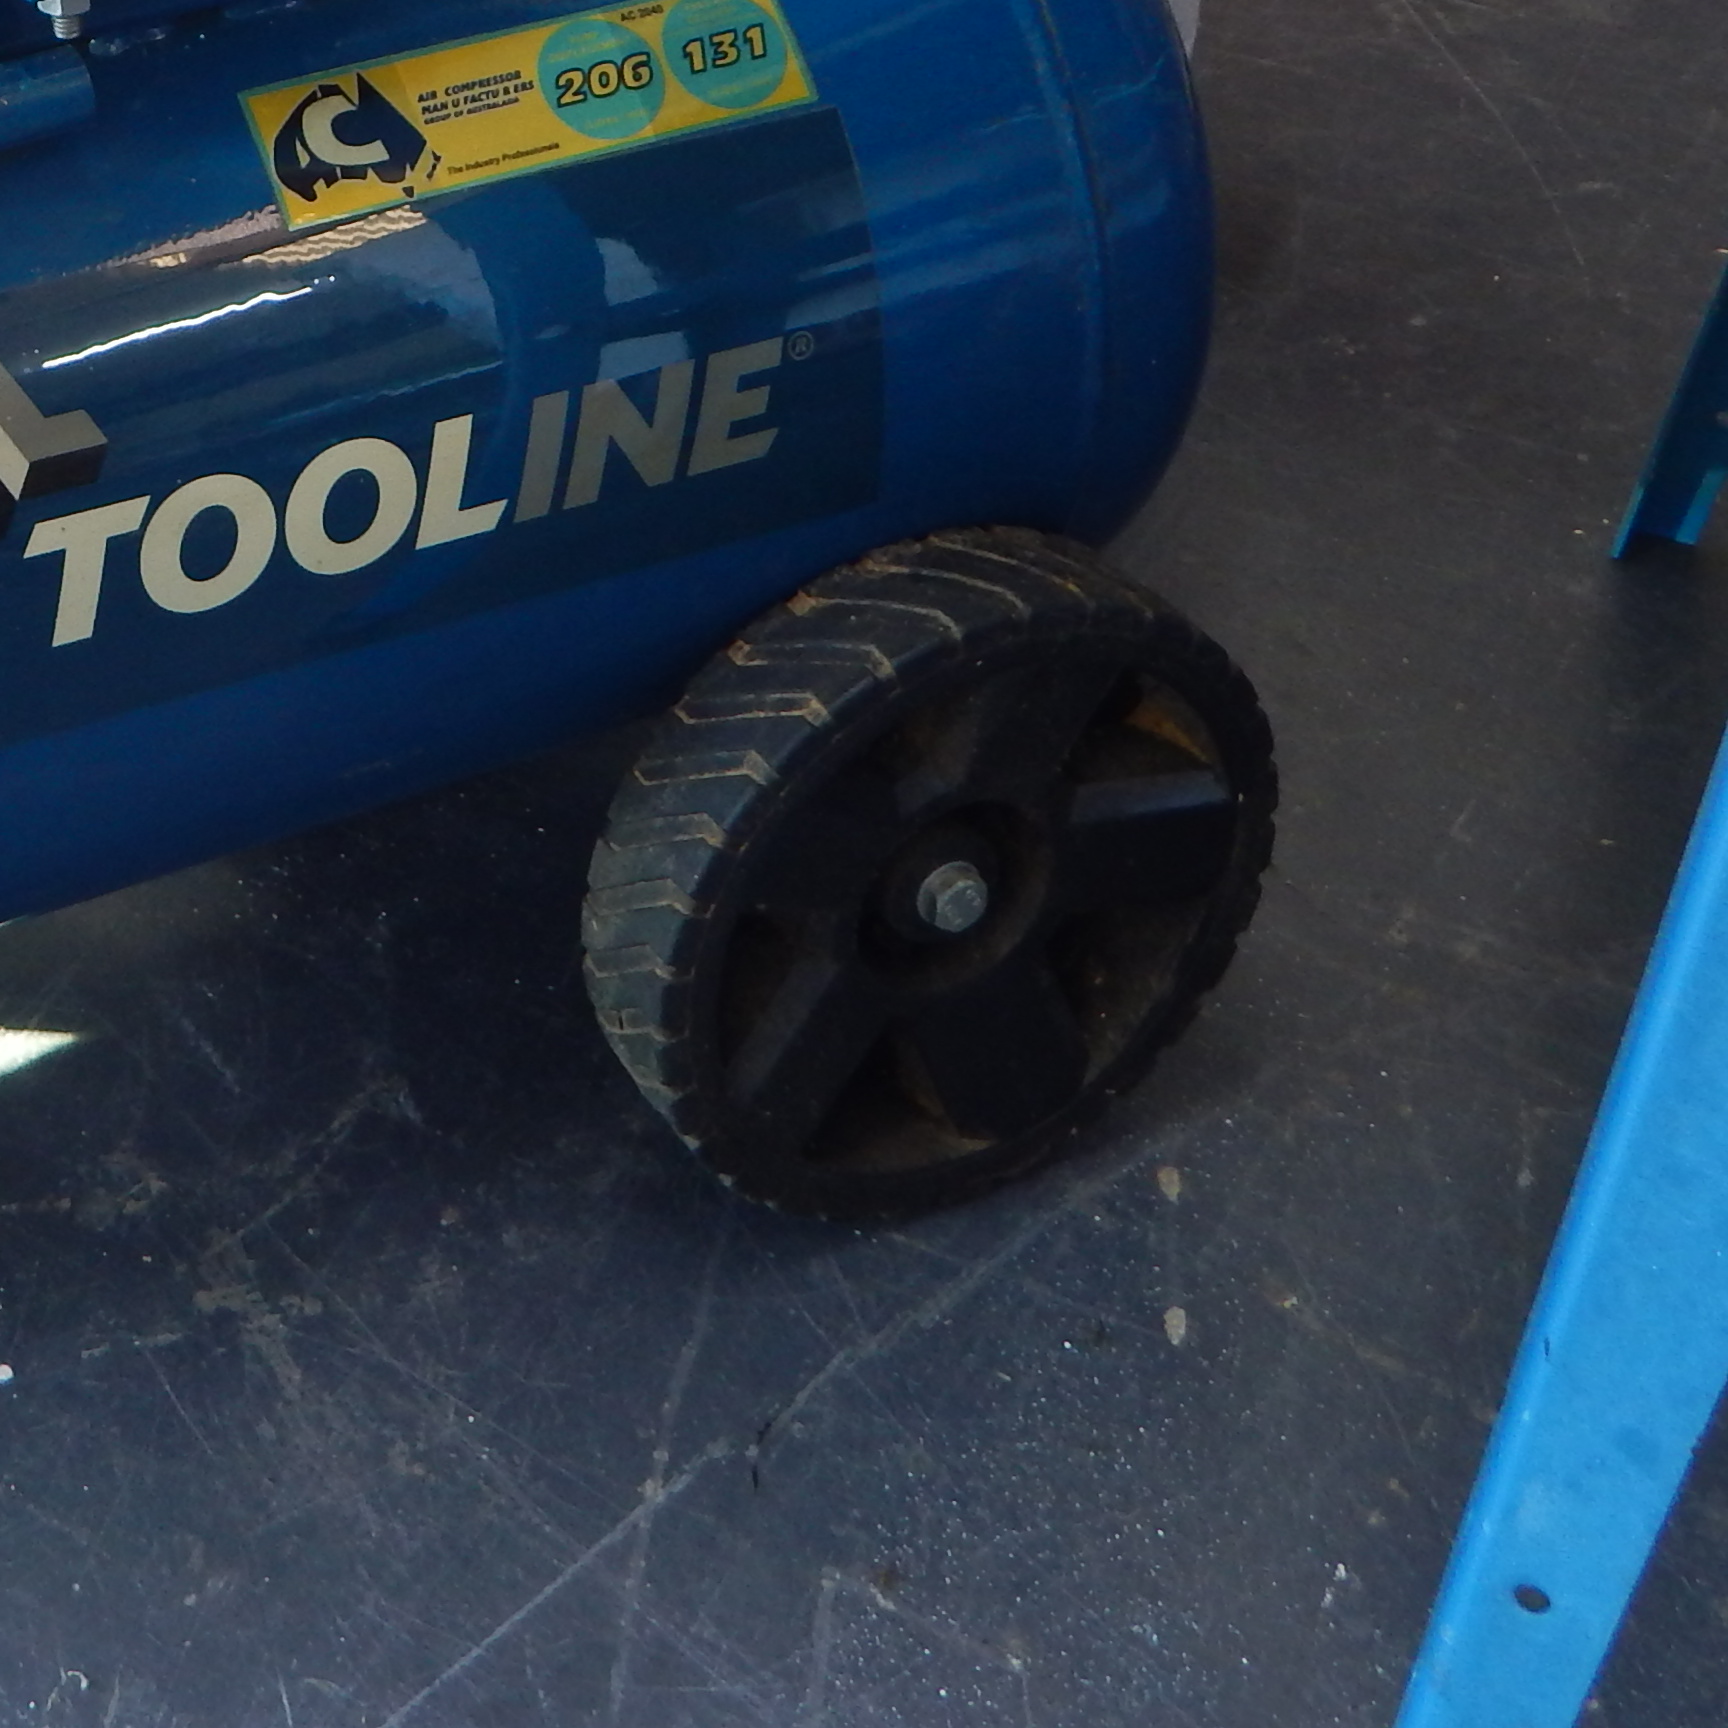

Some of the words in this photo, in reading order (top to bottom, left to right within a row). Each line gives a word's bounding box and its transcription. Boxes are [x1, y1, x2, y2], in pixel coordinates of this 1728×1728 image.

[682, 22, 767, 75] 131
[418, 90, 438, 103] AIR
[444, 70, 522, 97] COMPRESSOR
[555, 51, 653, 108] 206
[447, 166, 464, 175] The
[465, 156, 501, 172] Industry
[23, 336, 784, 648] TOOLINE
